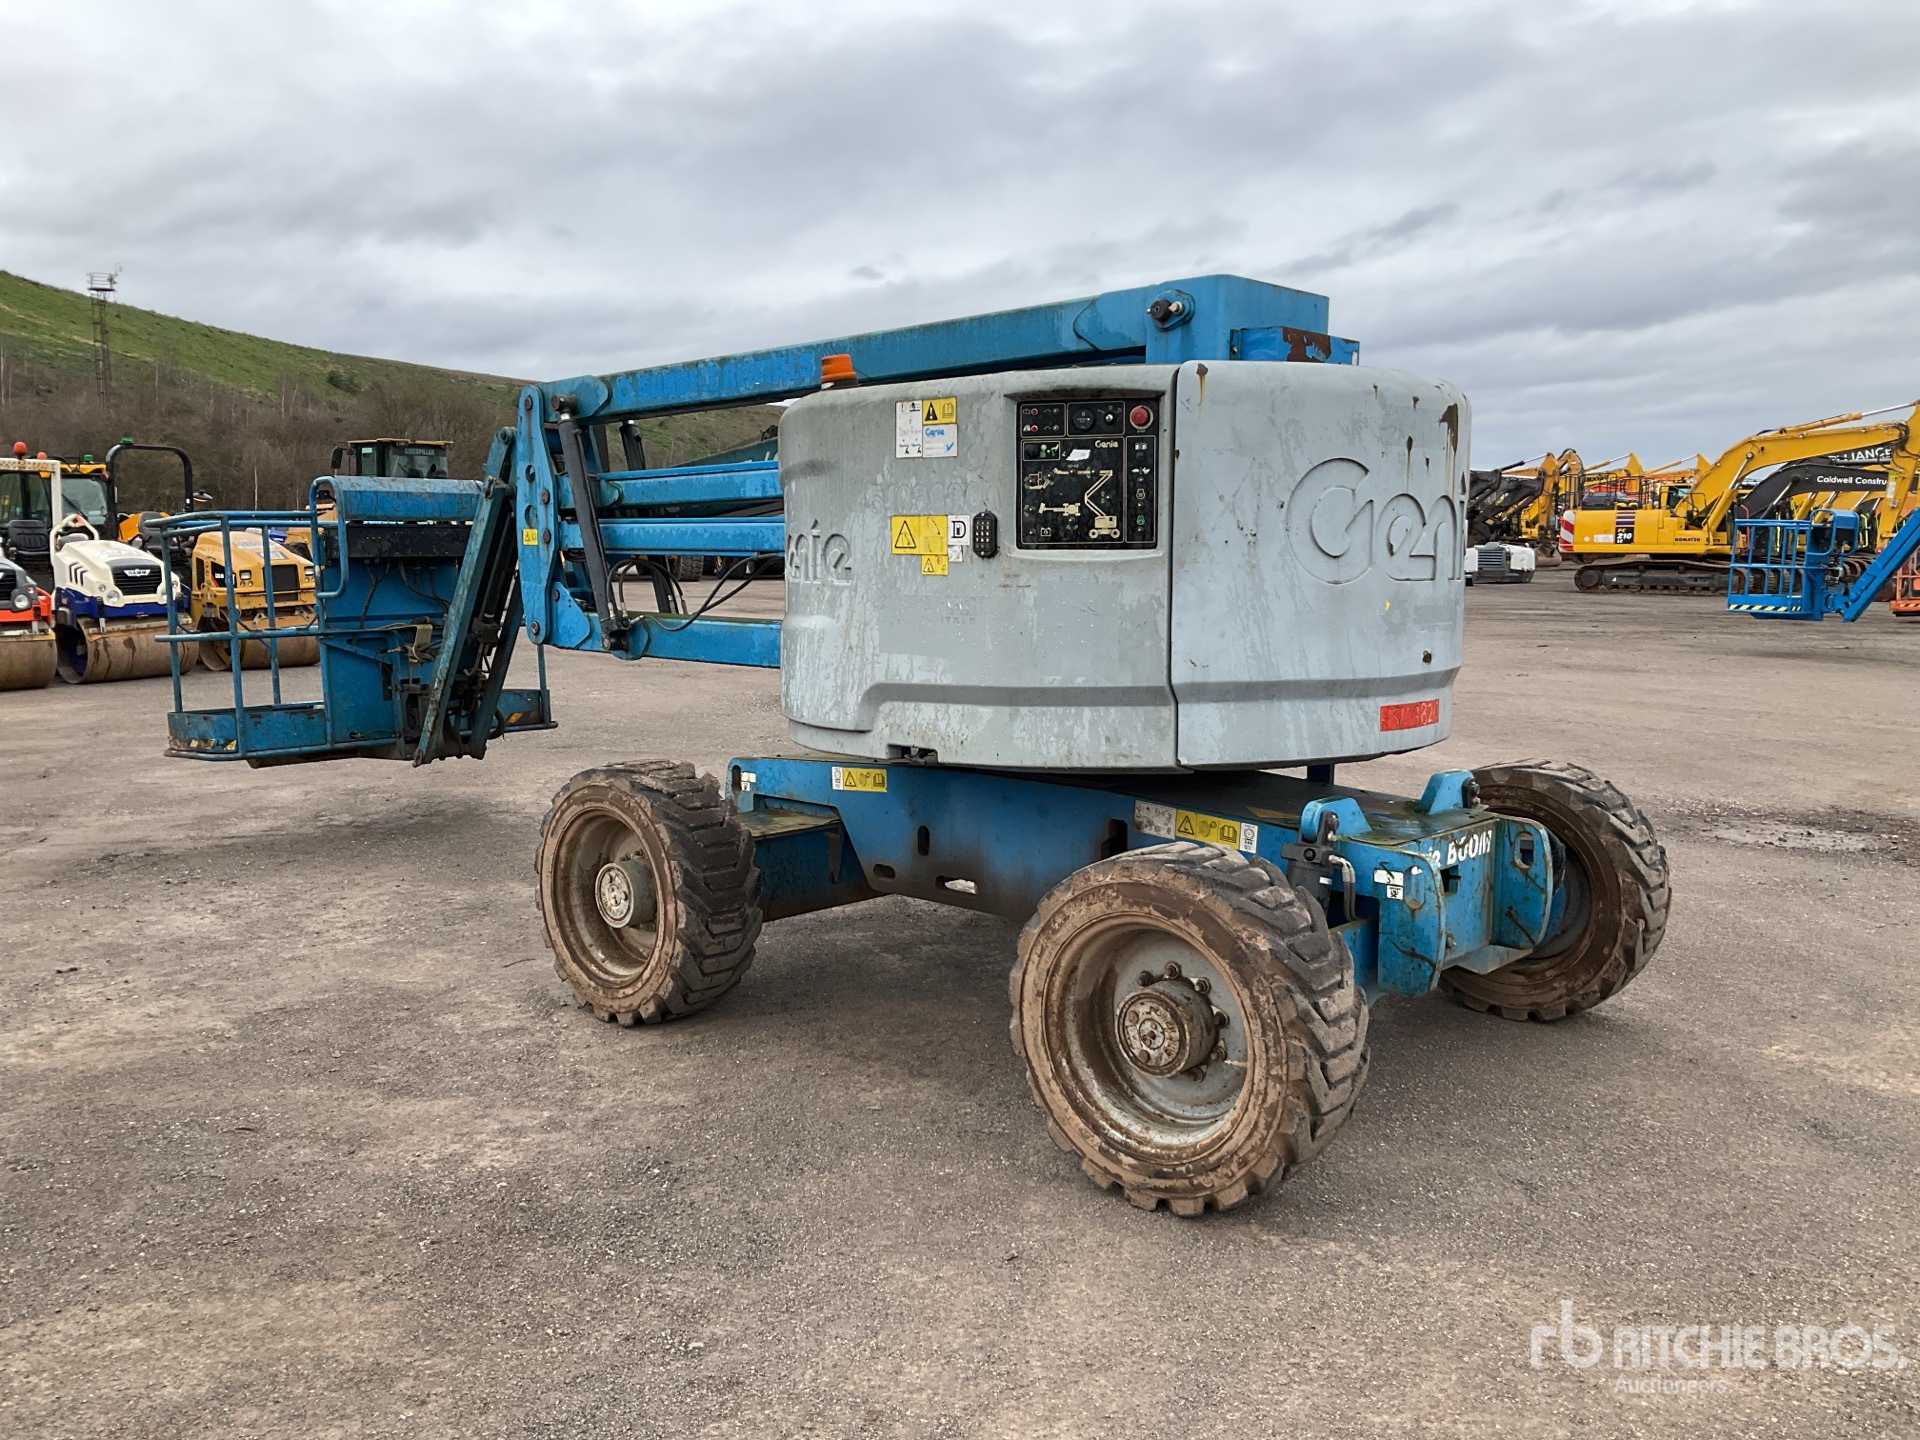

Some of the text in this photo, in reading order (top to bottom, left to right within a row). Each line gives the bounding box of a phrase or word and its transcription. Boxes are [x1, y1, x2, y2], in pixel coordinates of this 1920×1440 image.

[925, 427, 945, 437] Genie
[1093, 440, 1119, 448] Genie
[1817, 475, 1853, 483] Caldwell
